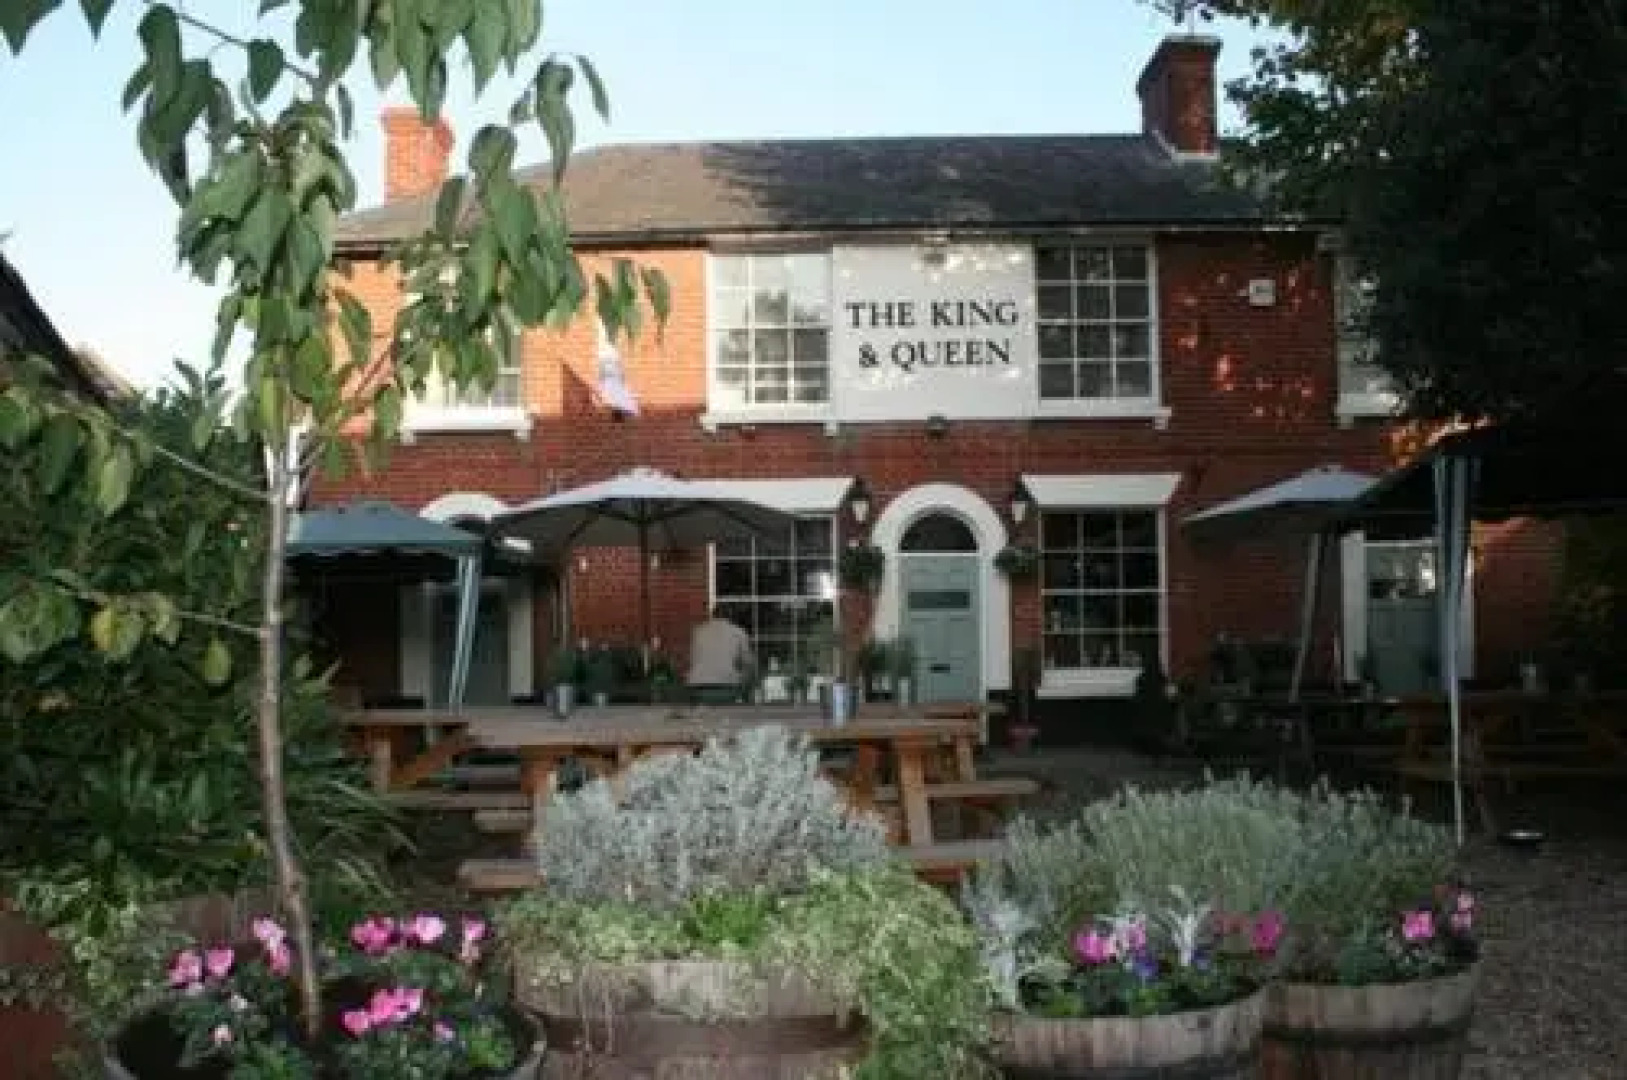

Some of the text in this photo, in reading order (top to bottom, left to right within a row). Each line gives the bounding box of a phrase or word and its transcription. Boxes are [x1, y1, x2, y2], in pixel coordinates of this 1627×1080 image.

[845, 300, 1019, 328] THE KING
[859, 338, 1010, 374] & QUEEN
